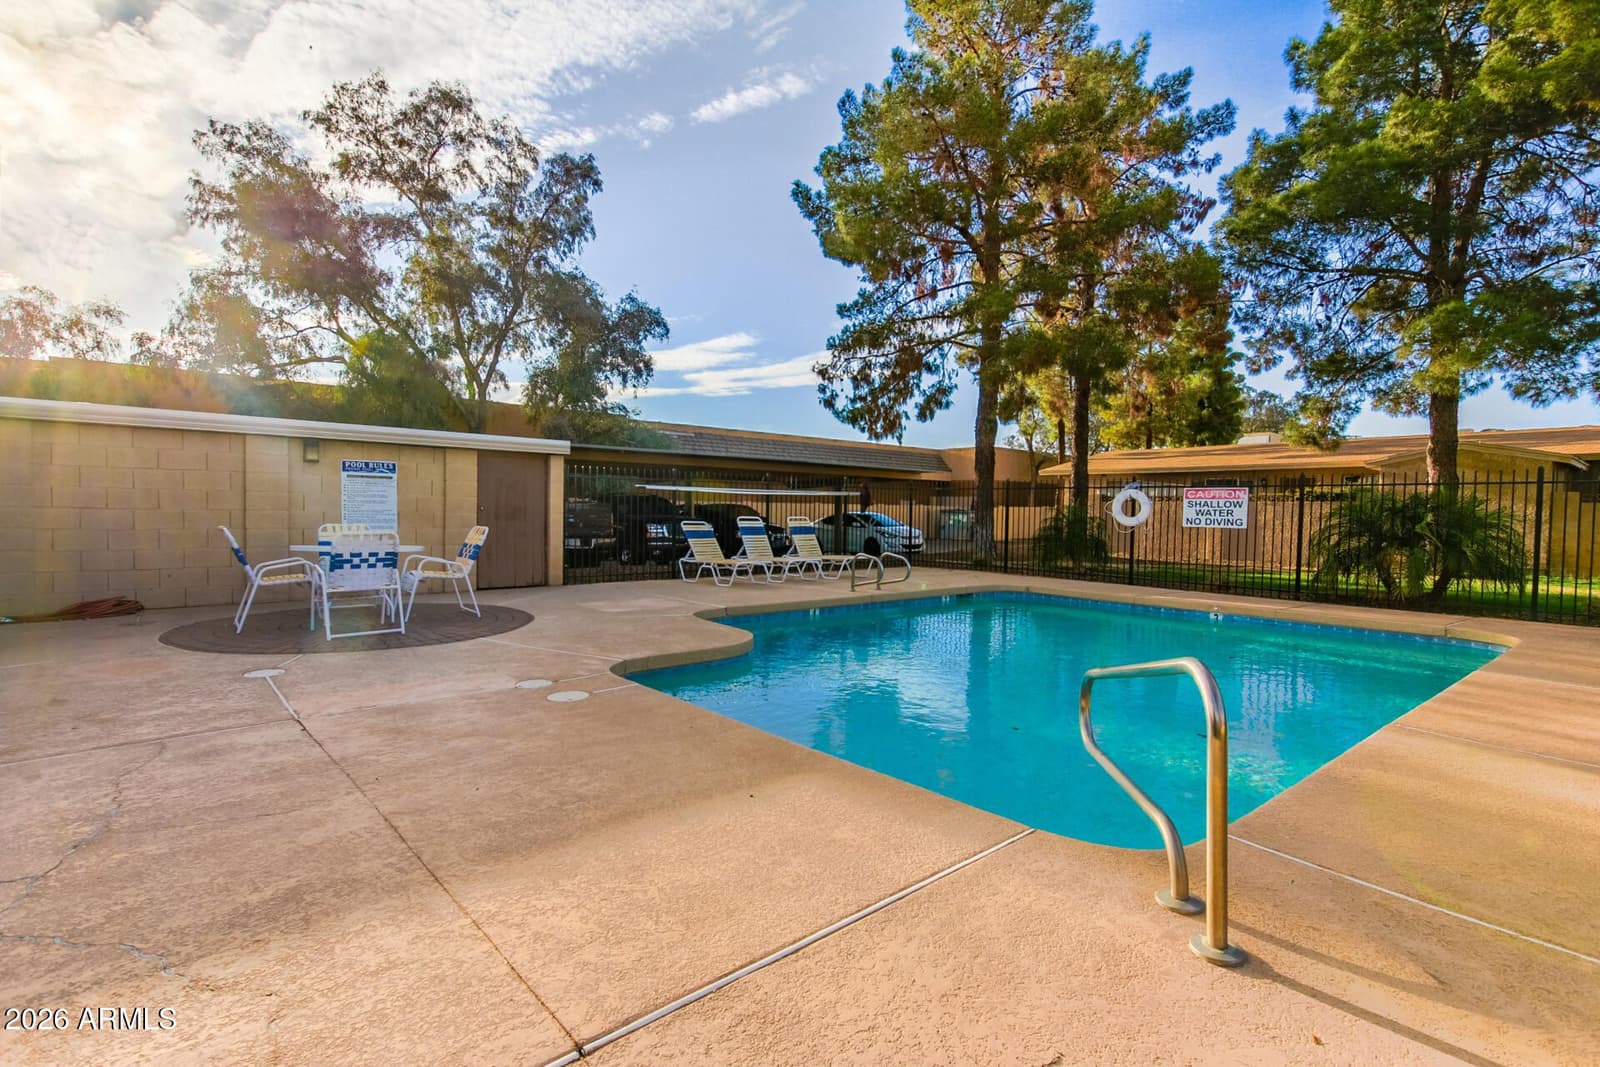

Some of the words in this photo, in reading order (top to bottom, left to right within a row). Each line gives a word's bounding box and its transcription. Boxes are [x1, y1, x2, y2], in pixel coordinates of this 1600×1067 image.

[1187, 490, 1245, 498] CAUTION
[1187, 500, 1243, 508] SHALLOW
[1195, 509, 1234, 517] WATER
[1205, 518, 1243, 526] DIVING
